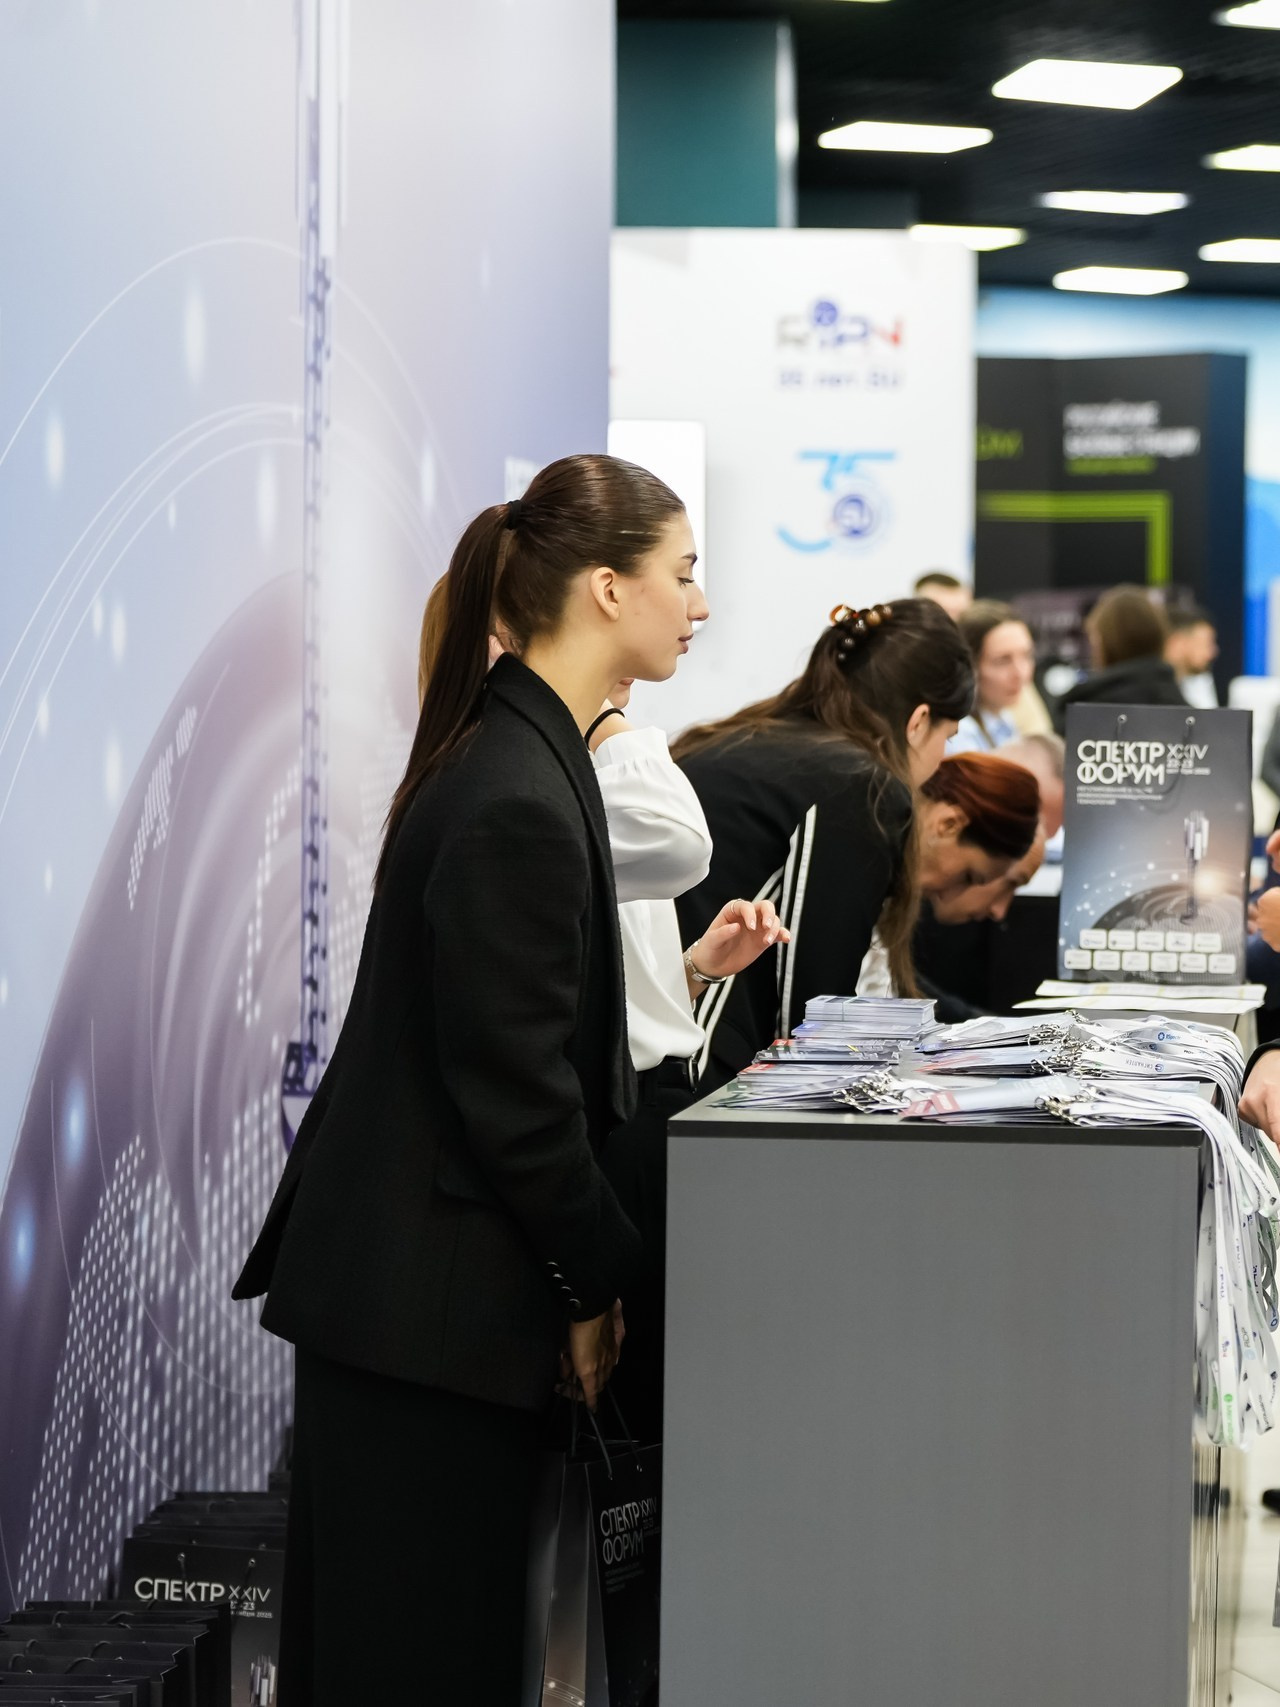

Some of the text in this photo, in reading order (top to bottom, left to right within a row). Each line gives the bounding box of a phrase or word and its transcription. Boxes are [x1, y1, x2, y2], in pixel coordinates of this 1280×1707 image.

[1077, 740, 1209, 764] СПЕКТР XXIV
[1077, 762, 1165, 785] ФОРУМ
[600, 1501, 640, 1537] СПЕКТР
[603, 1528, 644, 1565] ФОРУМ
[134, 1577, 271, 1602] СПЕКТР XXIV
